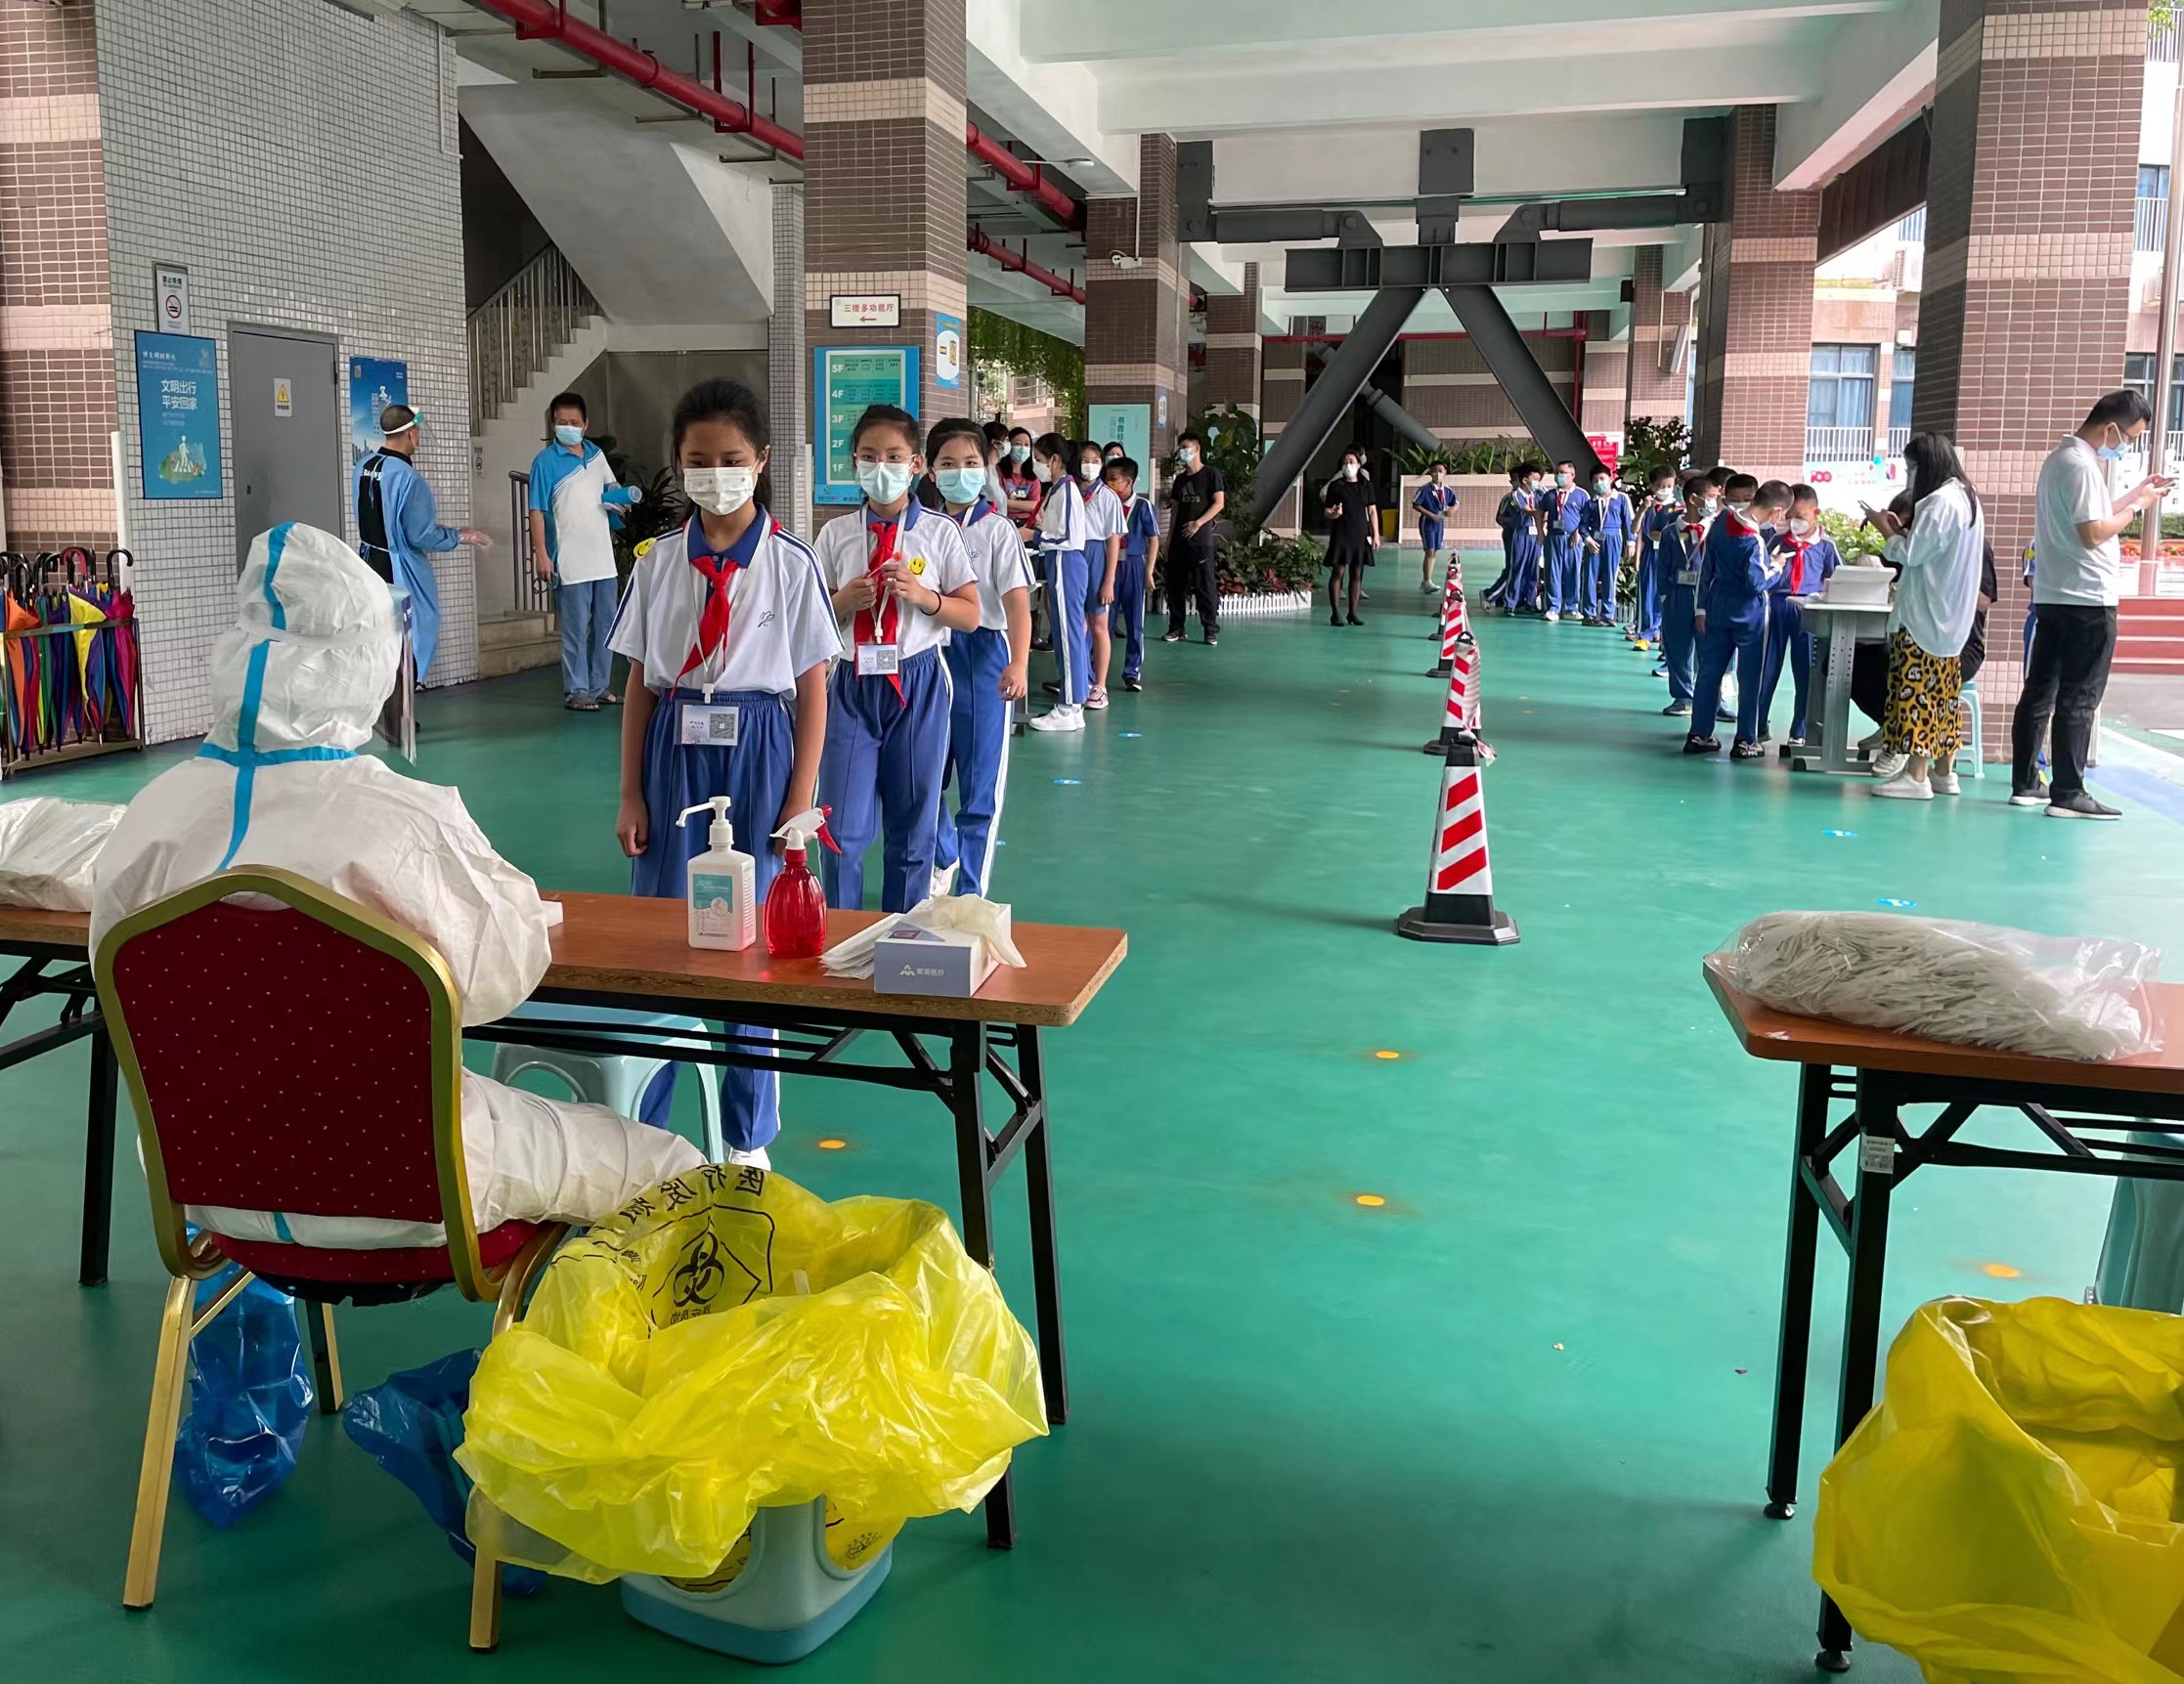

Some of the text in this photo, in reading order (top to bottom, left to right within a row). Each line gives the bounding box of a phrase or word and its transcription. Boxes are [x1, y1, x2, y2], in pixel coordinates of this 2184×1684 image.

[844, 303, 895, 313] 三楼多功能厅
[160, 379, 197, 395] 文明出行
[831, 390, 845, 399] 4F
[161, 395, 197, 410] 平安回家
[831, 414, 844, 423] 3F
